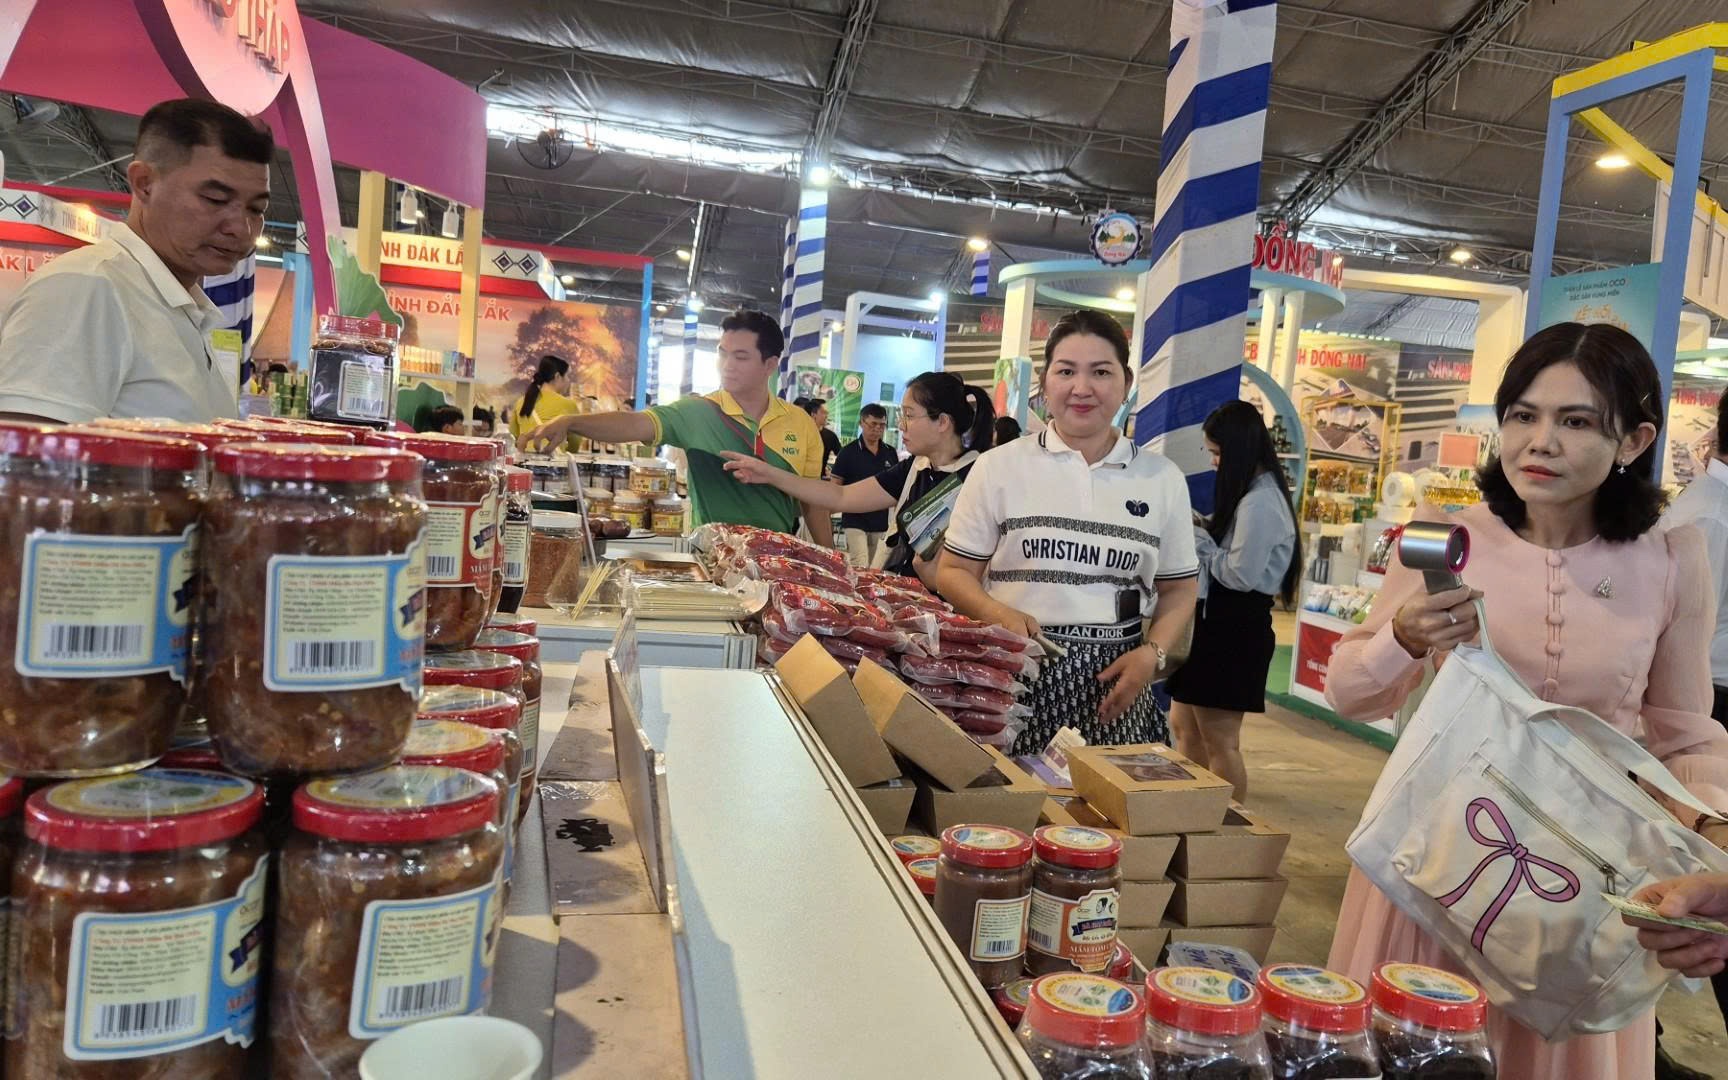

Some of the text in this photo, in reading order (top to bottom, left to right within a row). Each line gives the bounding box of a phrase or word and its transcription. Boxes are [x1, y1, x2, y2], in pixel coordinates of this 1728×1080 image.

[381, 241, 401, 258] NH
[445, 245, 464, 265] LẮ
[389, 291, 421, 313] ỈNH
[477, 298, 511, 321] ẮK
[1022, 538, 1140, 571] CHRISTIAN DIOR
[1043, 624, 1124, 638] STIAN DIOR
